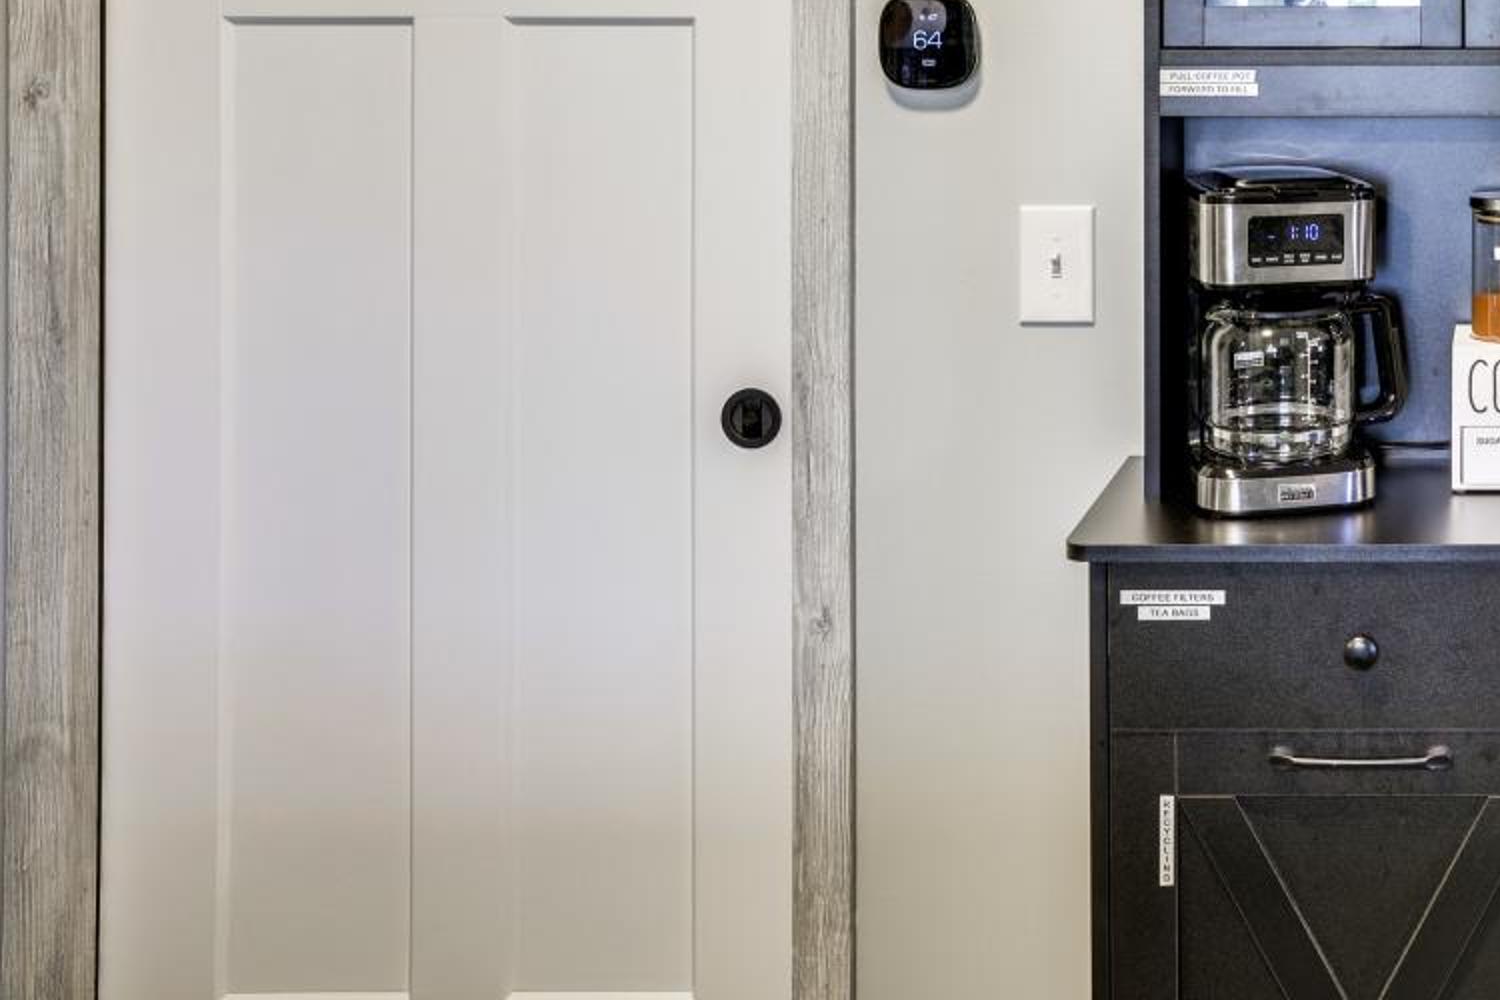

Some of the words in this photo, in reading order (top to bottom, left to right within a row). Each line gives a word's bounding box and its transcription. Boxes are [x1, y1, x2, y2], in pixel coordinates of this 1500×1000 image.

[912, 29, 943, 51] 64
[1169, 71, 1194, 81] PULL
[1195, 71, 1230, 81] COFFEE
[1168, 85, 1215, 93] FORWARD
[1216, 85, 1229, 93] TO
[1290, 223, 1319, 241] 1:10
[1131, 593, 1170, 602] COFFEE
[1173, 593, 1215, 602] FILTERS
[1150, 608, 1169, 617] TEA
[1171, 608, 1199, 617] BAGS
[1162, 799, 1172, 883] RECYCLING
